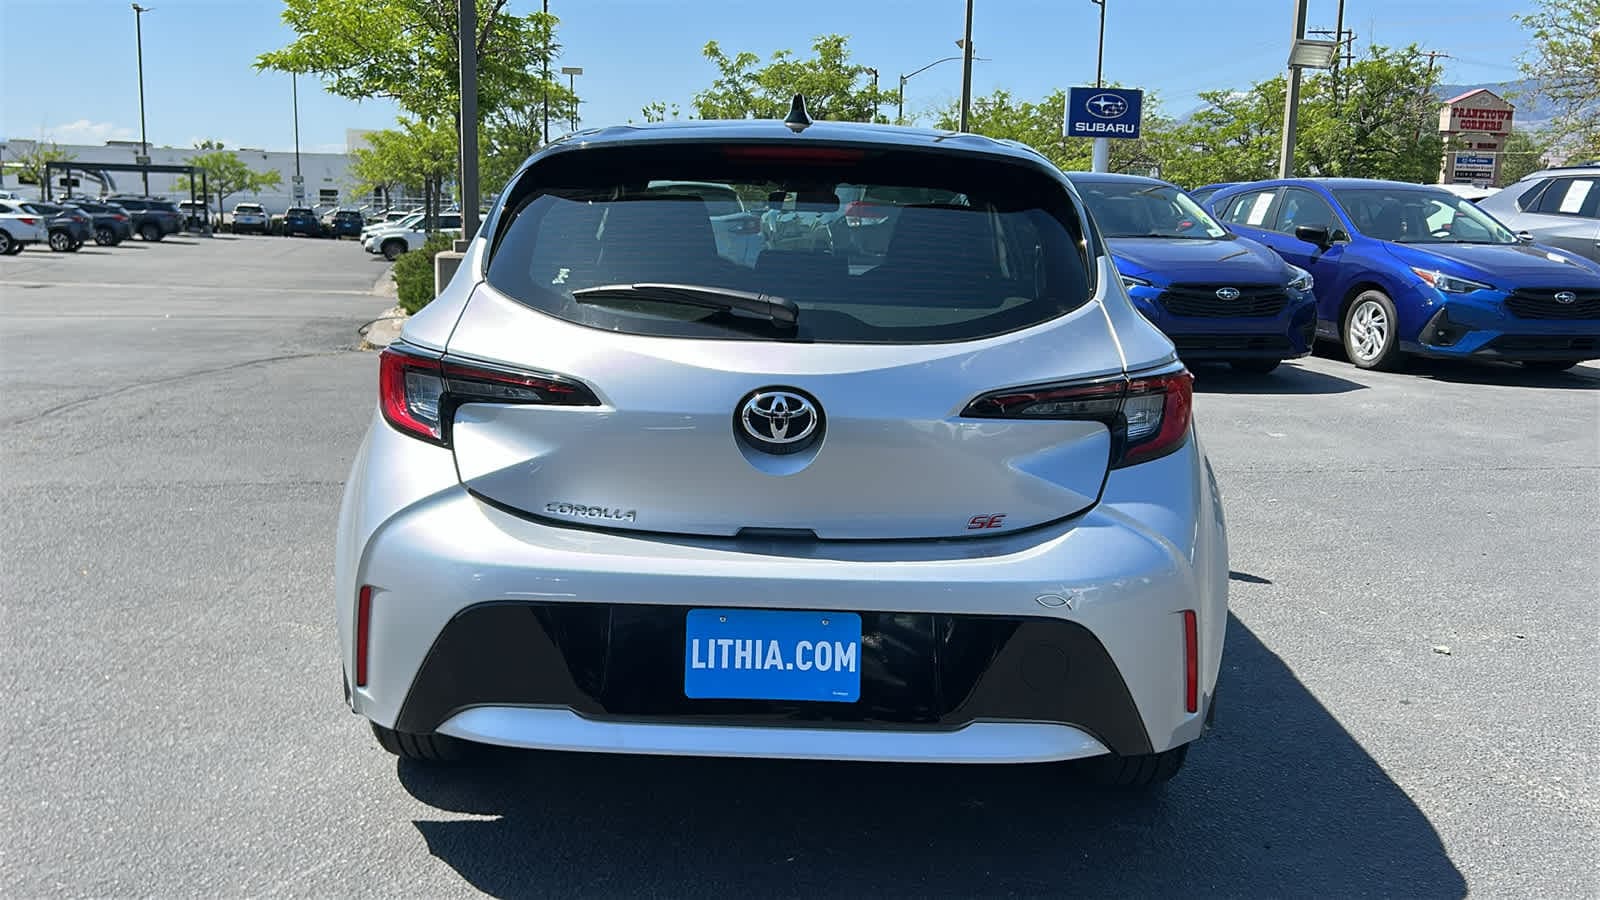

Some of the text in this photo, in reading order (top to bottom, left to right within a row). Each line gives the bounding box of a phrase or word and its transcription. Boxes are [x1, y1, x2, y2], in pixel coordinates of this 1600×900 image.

[1075, 122, 1135, 133] SUBARU
[1460, 120, 1503, 131] CORNERS
[545, 501, 637, 522] COROLLA
[967, 513, 1007, 529] SE
[691, 638, 857, 673] LITHIA.COM
